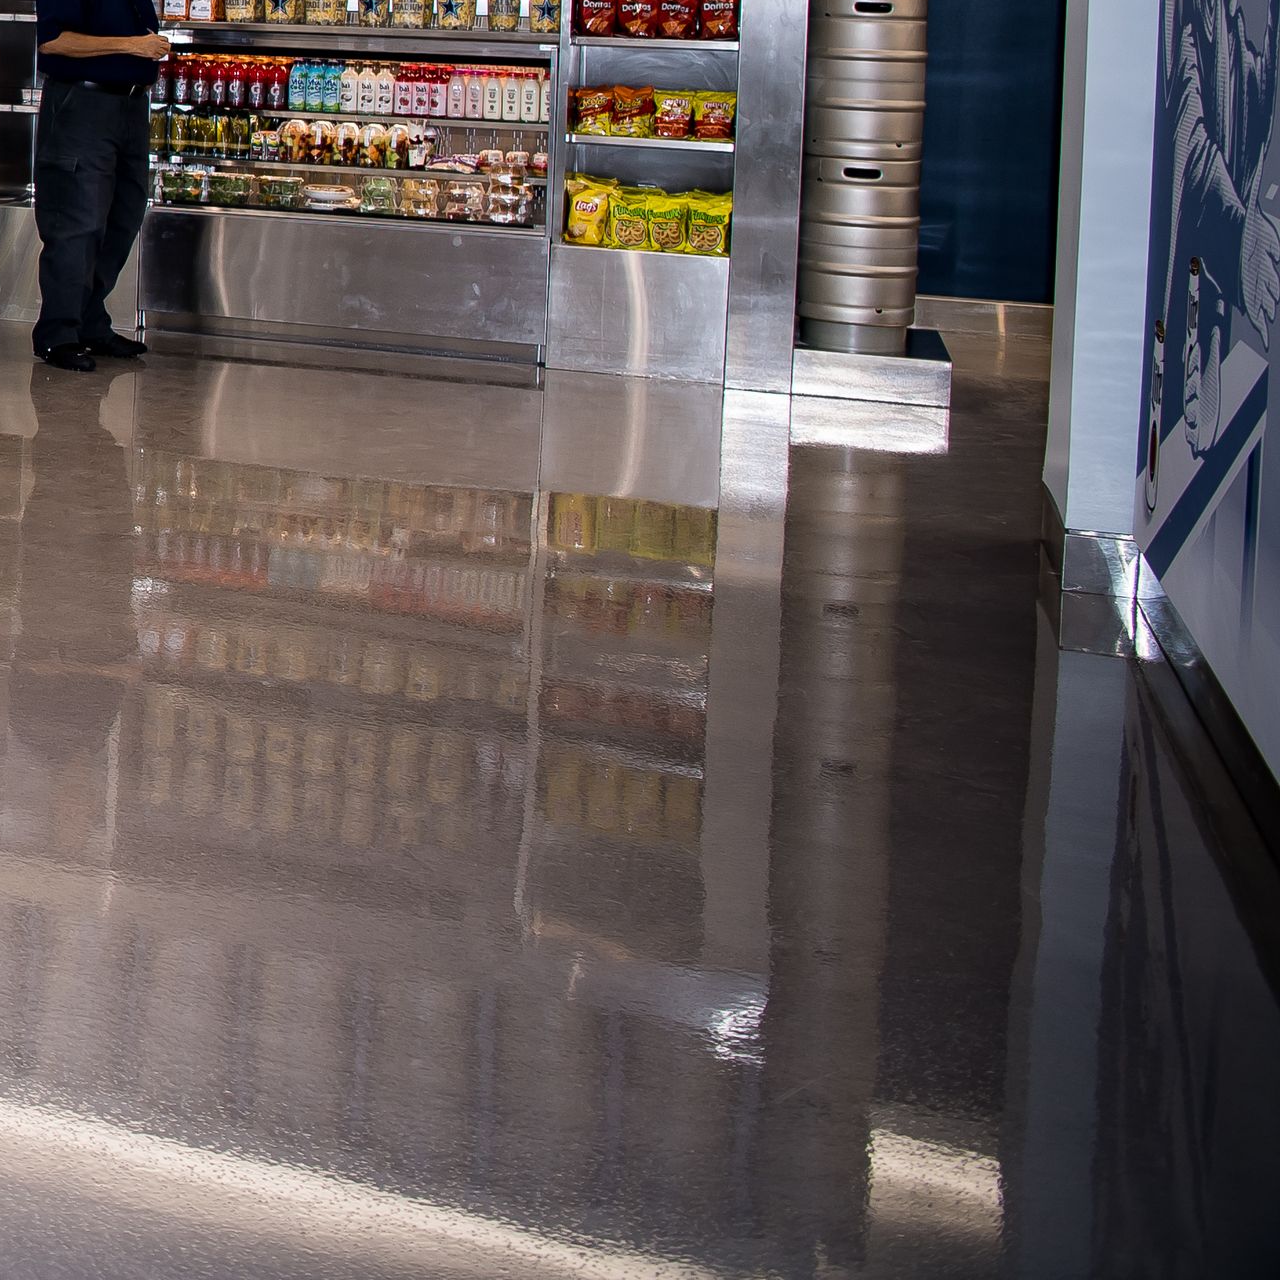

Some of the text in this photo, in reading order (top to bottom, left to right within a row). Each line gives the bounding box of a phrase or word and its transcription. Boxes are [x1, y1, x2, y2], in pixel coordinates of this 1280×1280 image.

[582, 0, 612, 9] Doritos
[622, 3, 652, 13] Doritos
[661, 2, 689, 14] Doritos
[703, 2, 734, 11] Doritos
